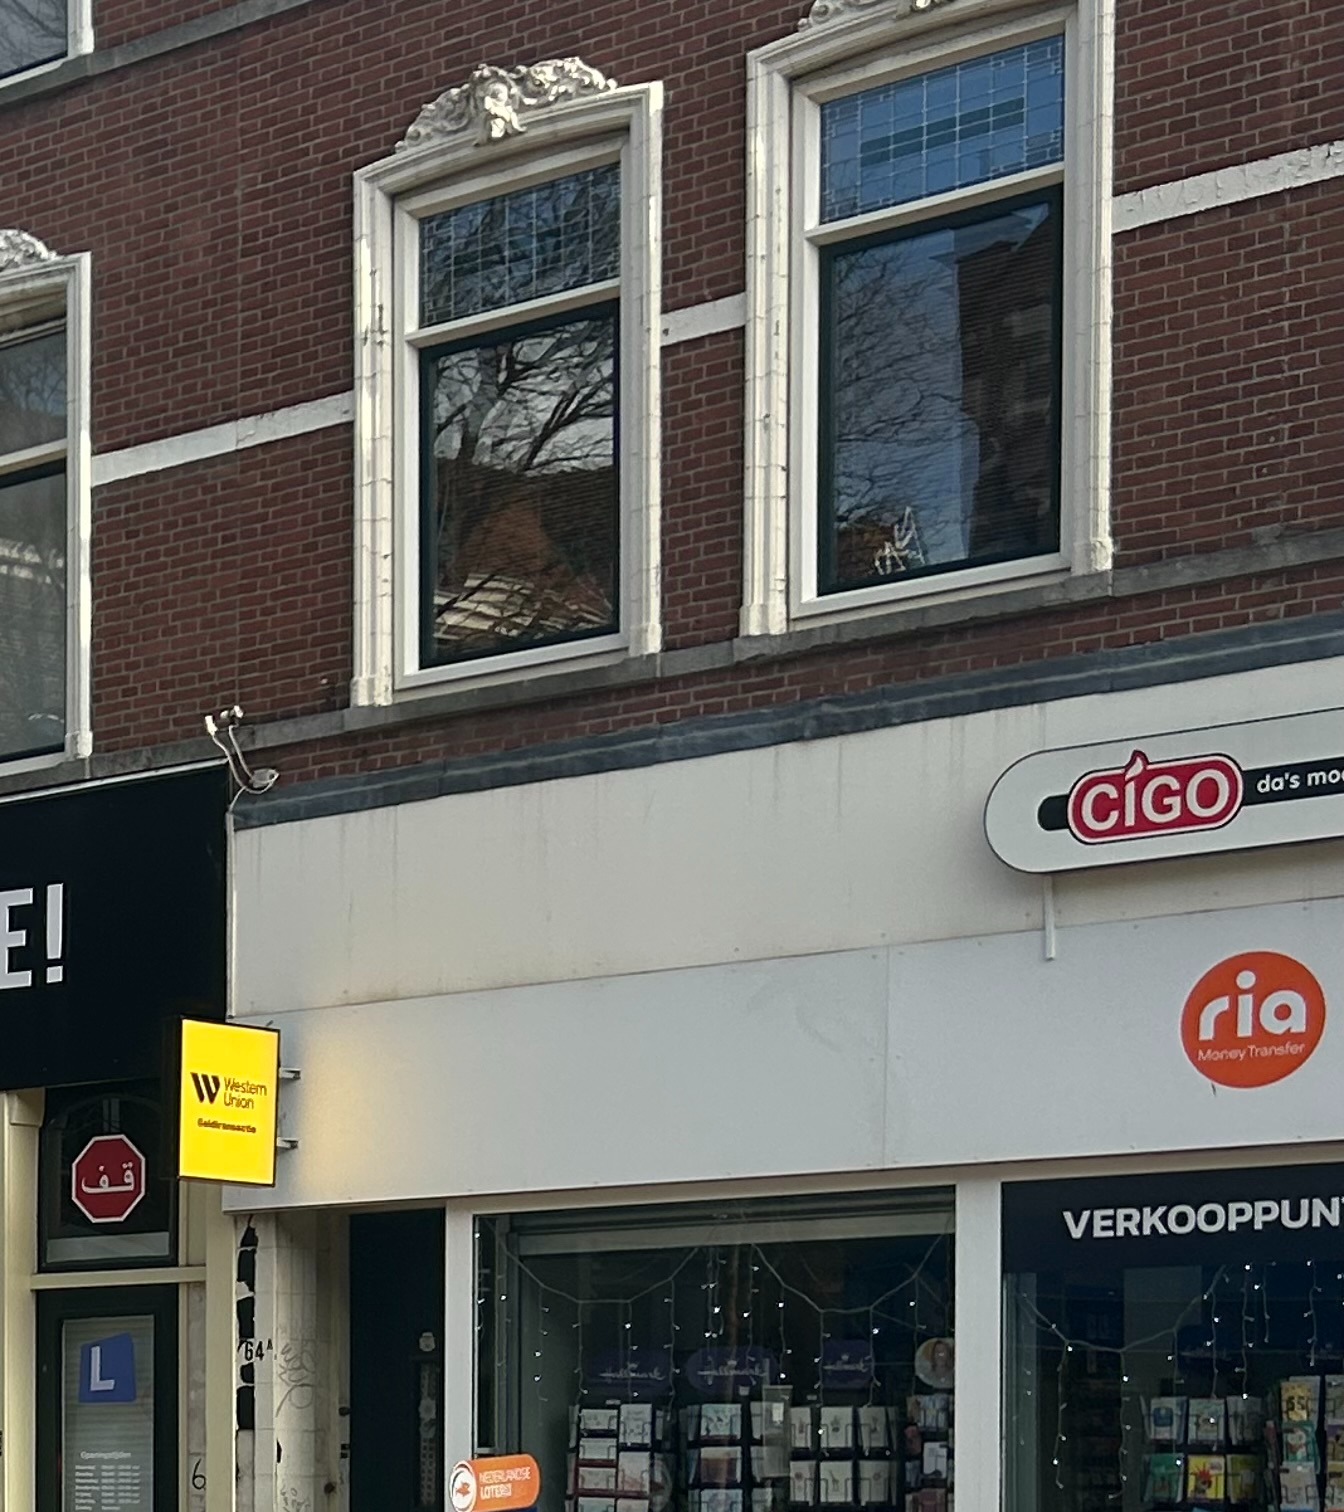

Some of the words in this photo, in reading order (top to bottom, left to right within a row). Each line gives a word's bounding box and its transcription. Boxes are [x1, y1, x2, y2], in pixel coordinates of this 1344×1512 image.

[1257, 771, 1301, 794] da's
[1198, 969, 1307, 1041] ria
[1197, 1048, 1247, 1062] Money
[1247, 1040, 1306, 1058] Transfer
[223, 1076, 268, 1096] Western
[223, 1091, 255, 1110] Union
[1062, 1196, 1344, 1240] VERKOOPPUN
[90, 1345, 116, 1392] L
